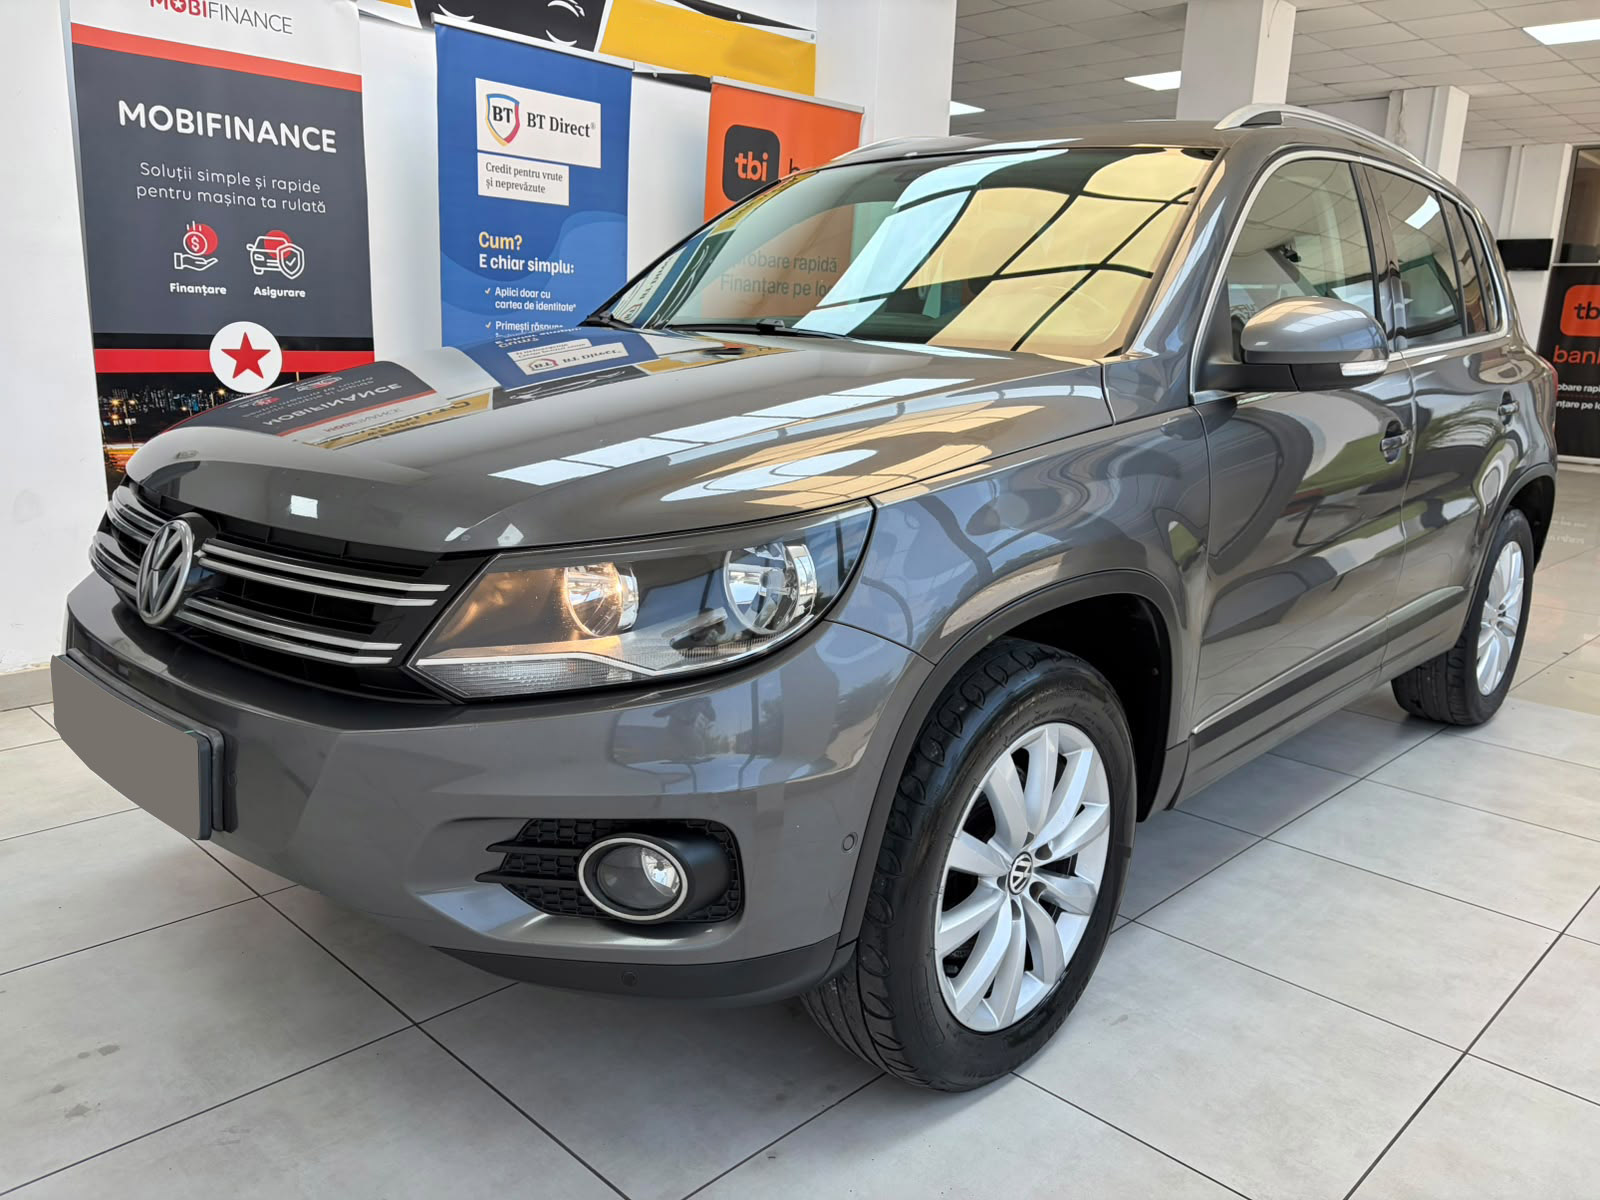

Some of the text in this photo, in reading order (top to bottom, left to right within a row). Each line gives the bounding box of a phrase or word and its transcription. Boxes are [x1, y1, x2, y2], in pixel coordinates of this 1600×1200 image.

[492, 105, 513, 124] BT
[527, 112, 546, 129] BT
[118, 100, 337, 154] MOBIFINANCE
[485, 161, 563, 182] Credit pentru vrute
[734, 151, 769, 182] tbi
[140, 161, 321, 195] Soluții simple și rapide
[495, 179, 546, 194] neprevăzute
[136, 184, 326, 214] pentru mașina ta rulată
[478, 231, 523, 251] Cum?
[479, 253, 575, 276] E chiar simplu:
[793, 255, 838, 274] rapidă
[169, 282, 227, 296] Finanțare
[253, 286, 306, 299] Asigurare
[495, 286, 551, 299] Aplici doar cu
[793, 282, 811, 298] pe
[495, 300, 523, 310] cartea
[523, 301, 535, 310] de
[1553, 344, 1600, 365] ban
